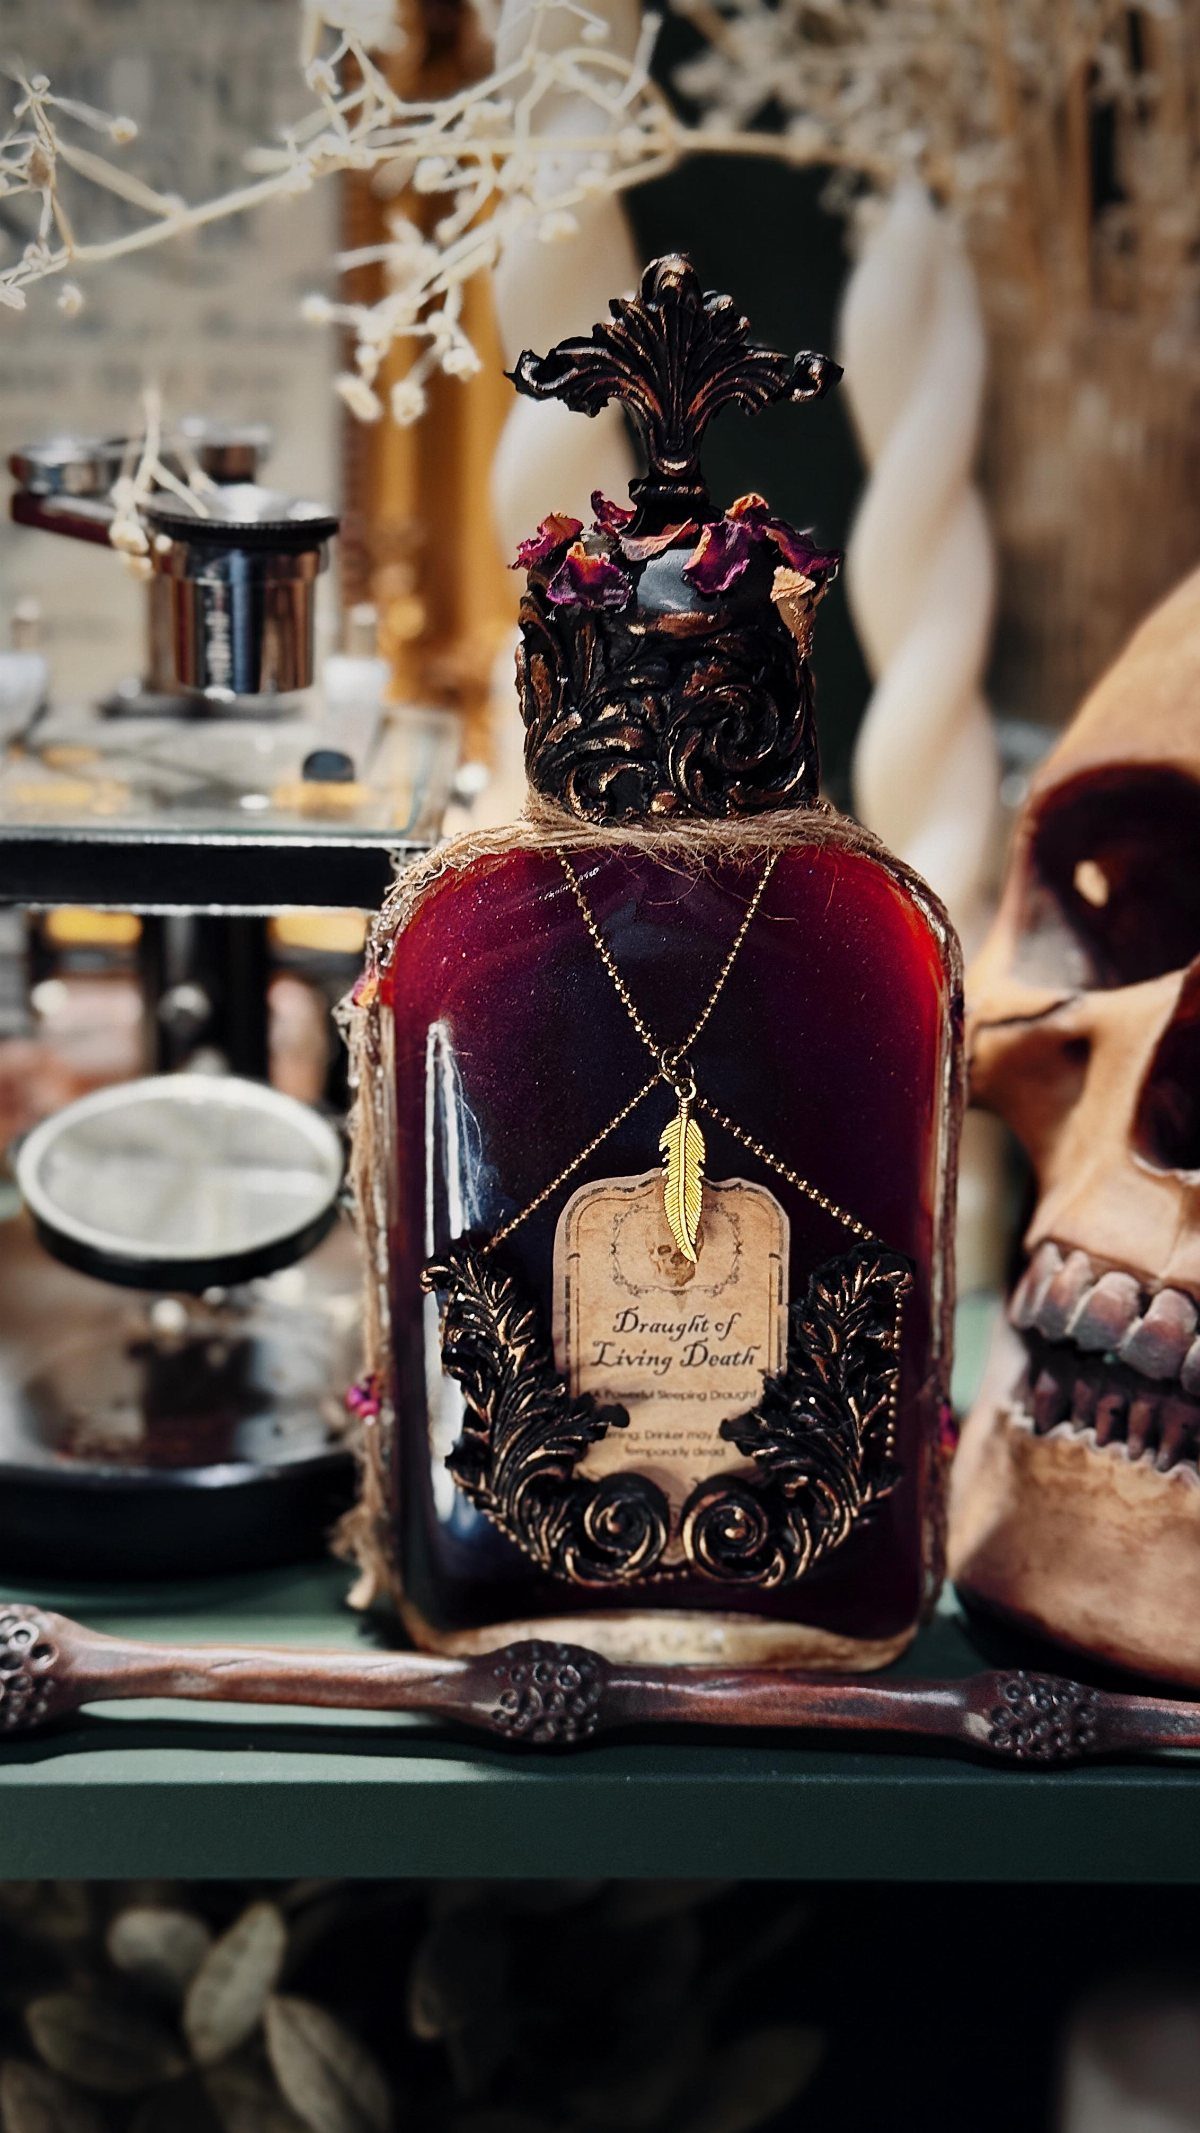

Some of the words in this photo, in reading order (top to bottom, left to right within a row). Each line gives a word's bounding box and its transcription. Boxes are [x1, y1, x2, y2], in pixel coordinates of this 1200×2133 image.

[612, 1306, 710, 1342] Draught
[715, 1312, 742, 1341] of
[590, 1341, 674, 1376] Living
[680, 1338, 761, 1369] Death
[604, 1388, 654, 1400] Powerful
[657, 1389, 707, 1402] Sleeping
[710, 1389, 757, 1401] Draught
[644, 1430, 683, 1440] Drinker
